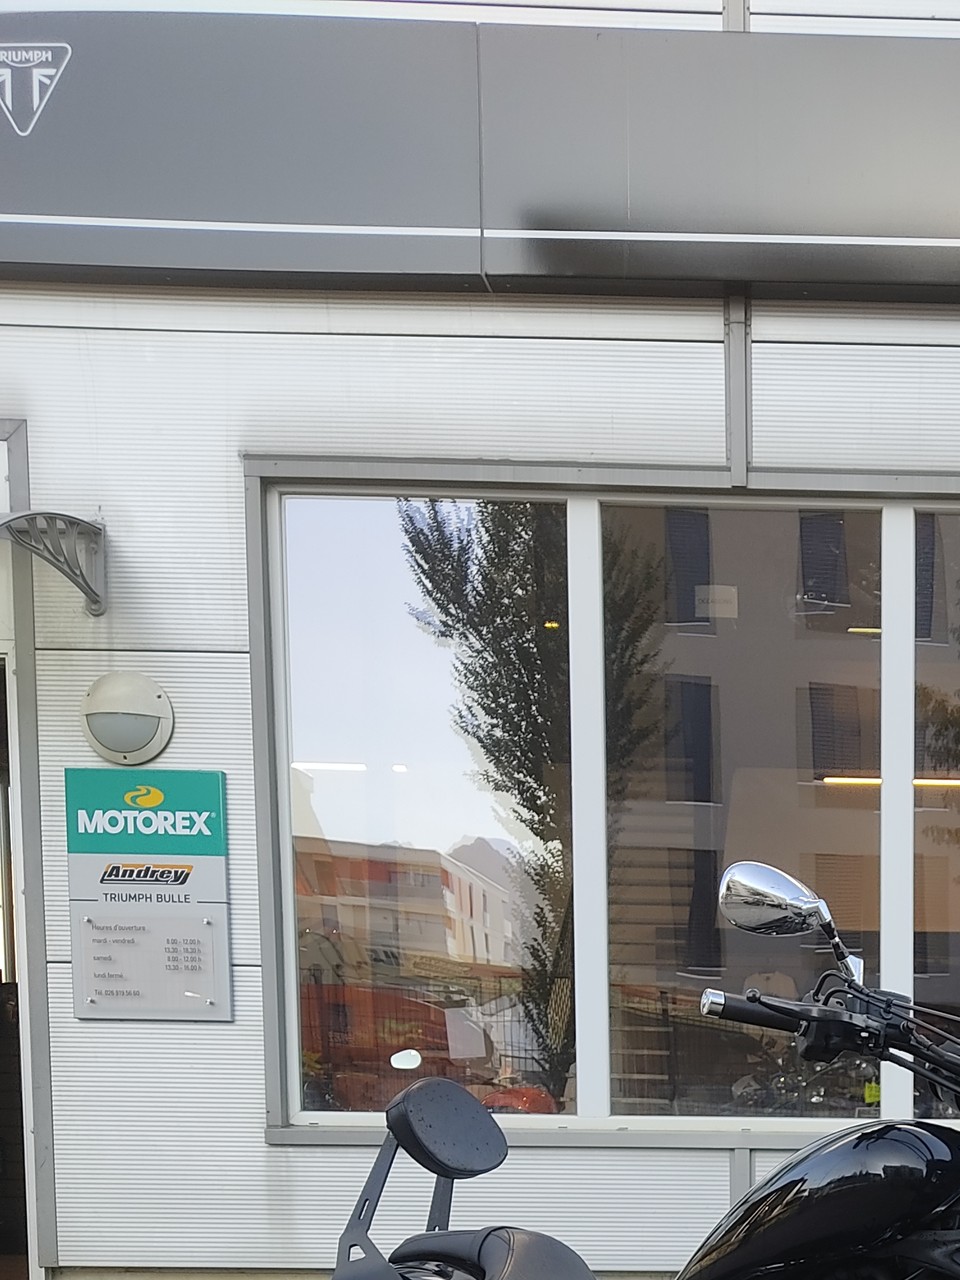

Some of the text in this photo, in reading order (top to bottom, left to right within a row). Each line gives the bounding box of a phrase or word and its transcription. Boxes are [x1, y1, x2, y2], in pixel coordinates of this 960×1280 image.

[0, 50, 52, 62] RIUMPH
[77, 809, 212, 836] MOTOREX
[106, 865, 184, 884] Andrey
[102, 893, 191, 904] TRIUMPH BULLE
